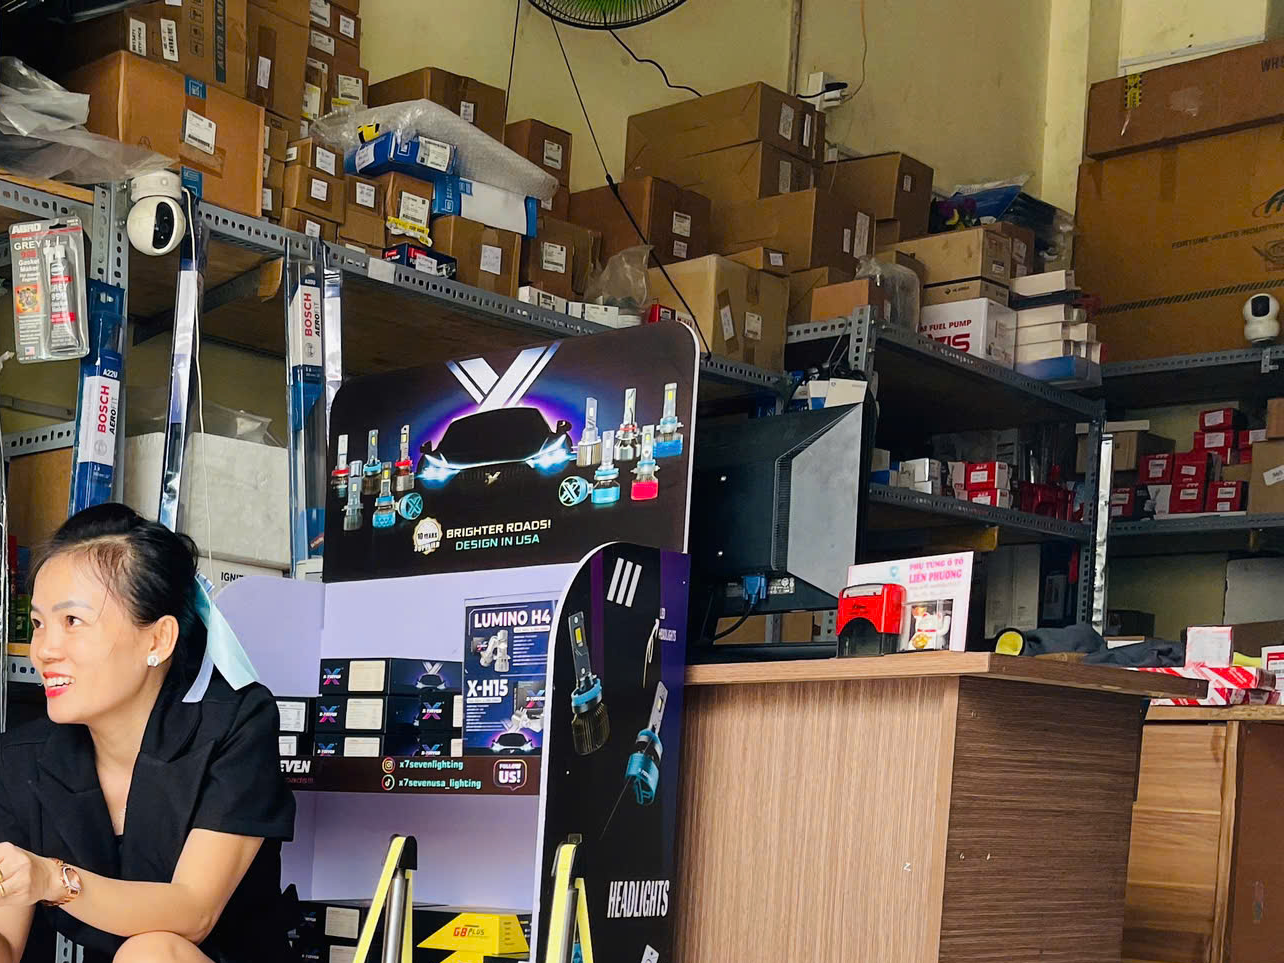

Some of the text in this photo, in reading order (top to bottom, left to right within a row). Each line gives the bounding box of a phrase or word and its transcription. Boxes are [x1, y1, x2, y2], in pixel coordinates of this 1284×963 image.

[14, 240, 42, 251] GREY
[304, 292, 313, 337] BOSCH
[313, 301, 321, 337] AEROFIT
[929, 319, 972, 332] FUEL PUMP
[98, 385, 110, 434] BOSCH
[109, 396, 118, 435] AEROFIT
[446, 519, 552, 539] BRIGHTER ROADS!
[455, 534, 540, 551] DESIGN IN USA
[474, 608, 551, 628] LUMINO H4
[466, 678, 509, 697] X-H15
[280, 760, 311, 773] EVEN
[399, 760, 463, 771] x7sevenlighting
[398, 778, 482, 790] x7sevenusa_lighting
[498, 771, 521, 783] US!
[607, 879, 670, 918] HEADLIGHTS
